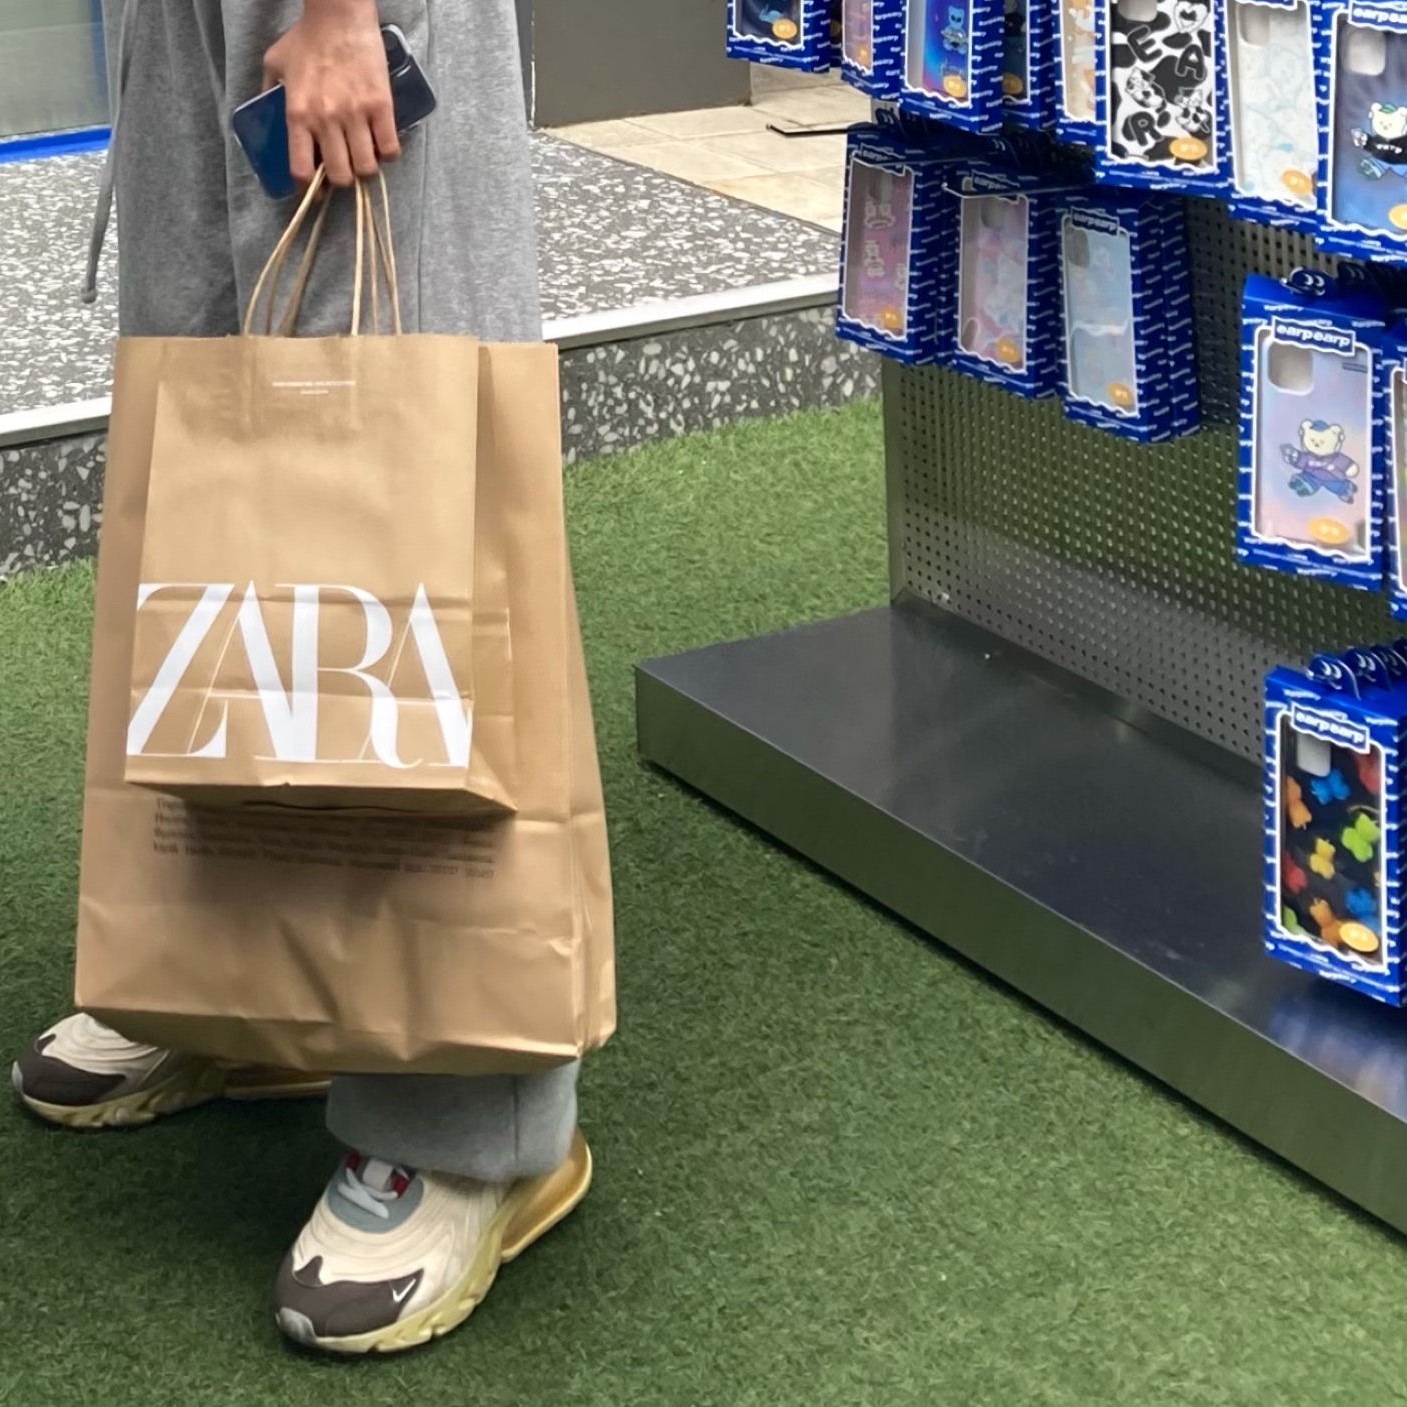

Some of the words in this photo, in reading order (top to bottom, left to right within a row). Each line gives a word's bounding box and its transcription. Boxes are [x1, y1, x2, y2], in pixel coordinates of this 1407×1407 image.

[1073, 212, 1116, 230] earpearp
[1276, 324, 1351, 347] earpearp
[126, 579, 474, 768] ZARA
[1296, 711, 1365, 744] earpearp
